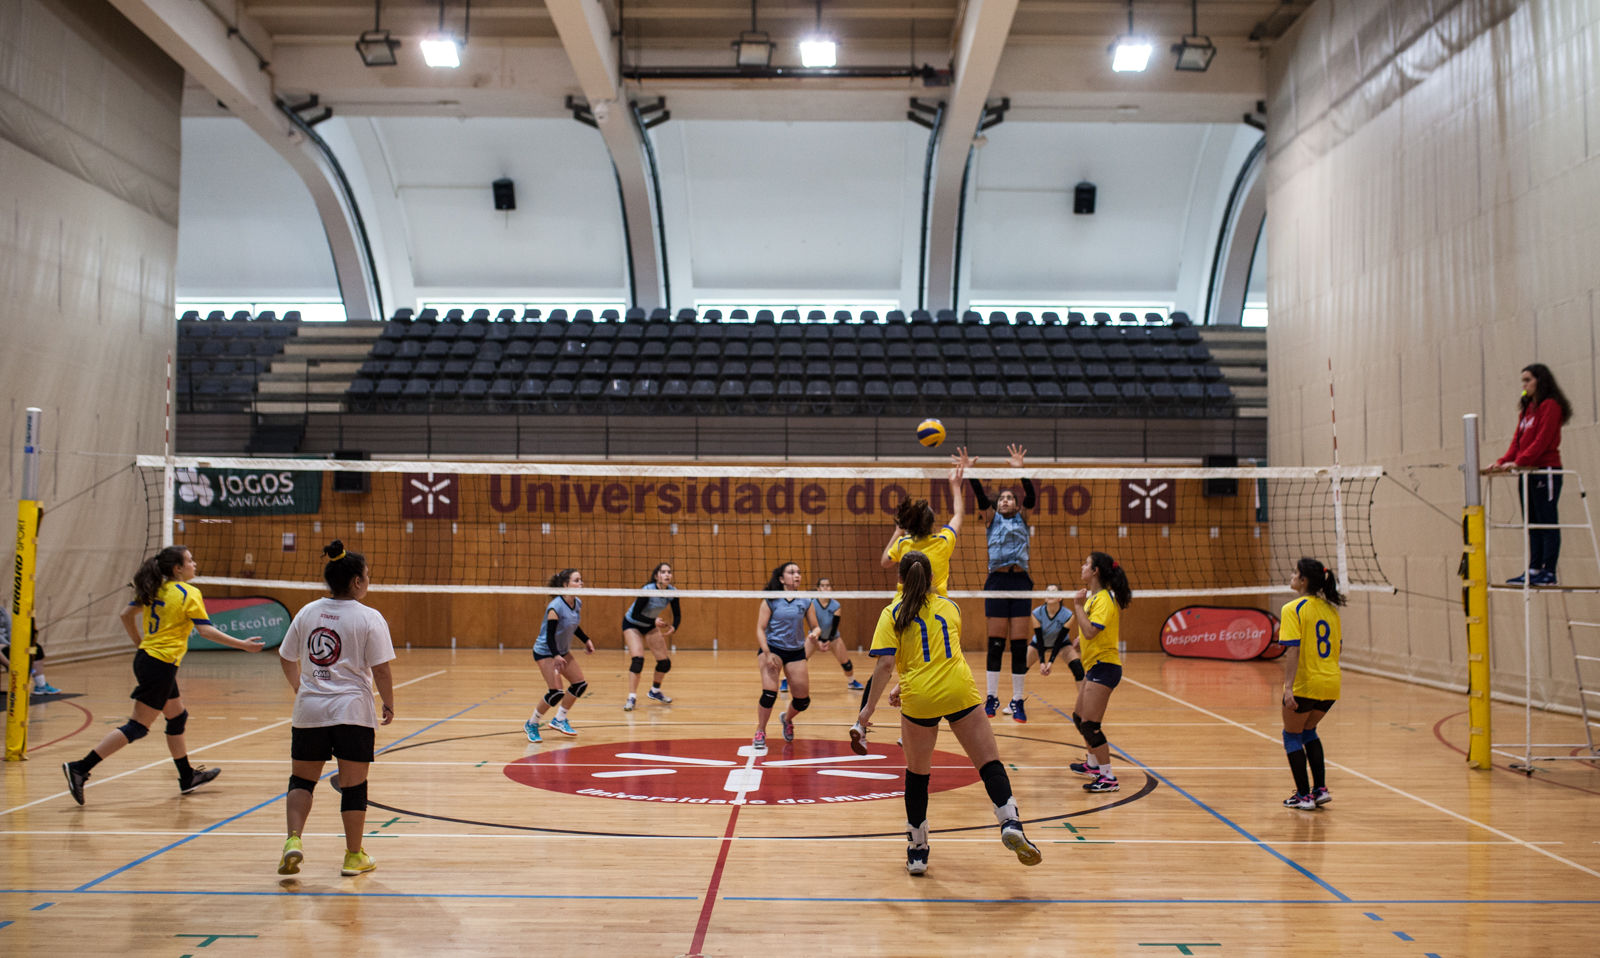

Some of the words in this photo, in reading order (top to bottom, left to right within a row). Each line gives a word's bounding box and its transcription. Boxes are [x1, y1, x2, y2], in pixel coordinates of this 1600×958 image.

[218, 471, 294, 501] JOGOS
[489, 473, 827, 515] Universidade
[846, 478, 907, 516] do
[16, 519, 26, 551] SPORT
[13, 553, 23, 616] ERHARD
[149, 600, 165, 634] 5
[231, 616, 284, 632] Escolar
[913, 613, 953, 663] 11
[1165, 630, 1217, 646] Desporto
[1218, 628, 1266, 642] Escolar
[1315, 619, 1331, 659] 8
[575, 788, 767, 804] Universidade
[819, 791, 905, 803] Minho
